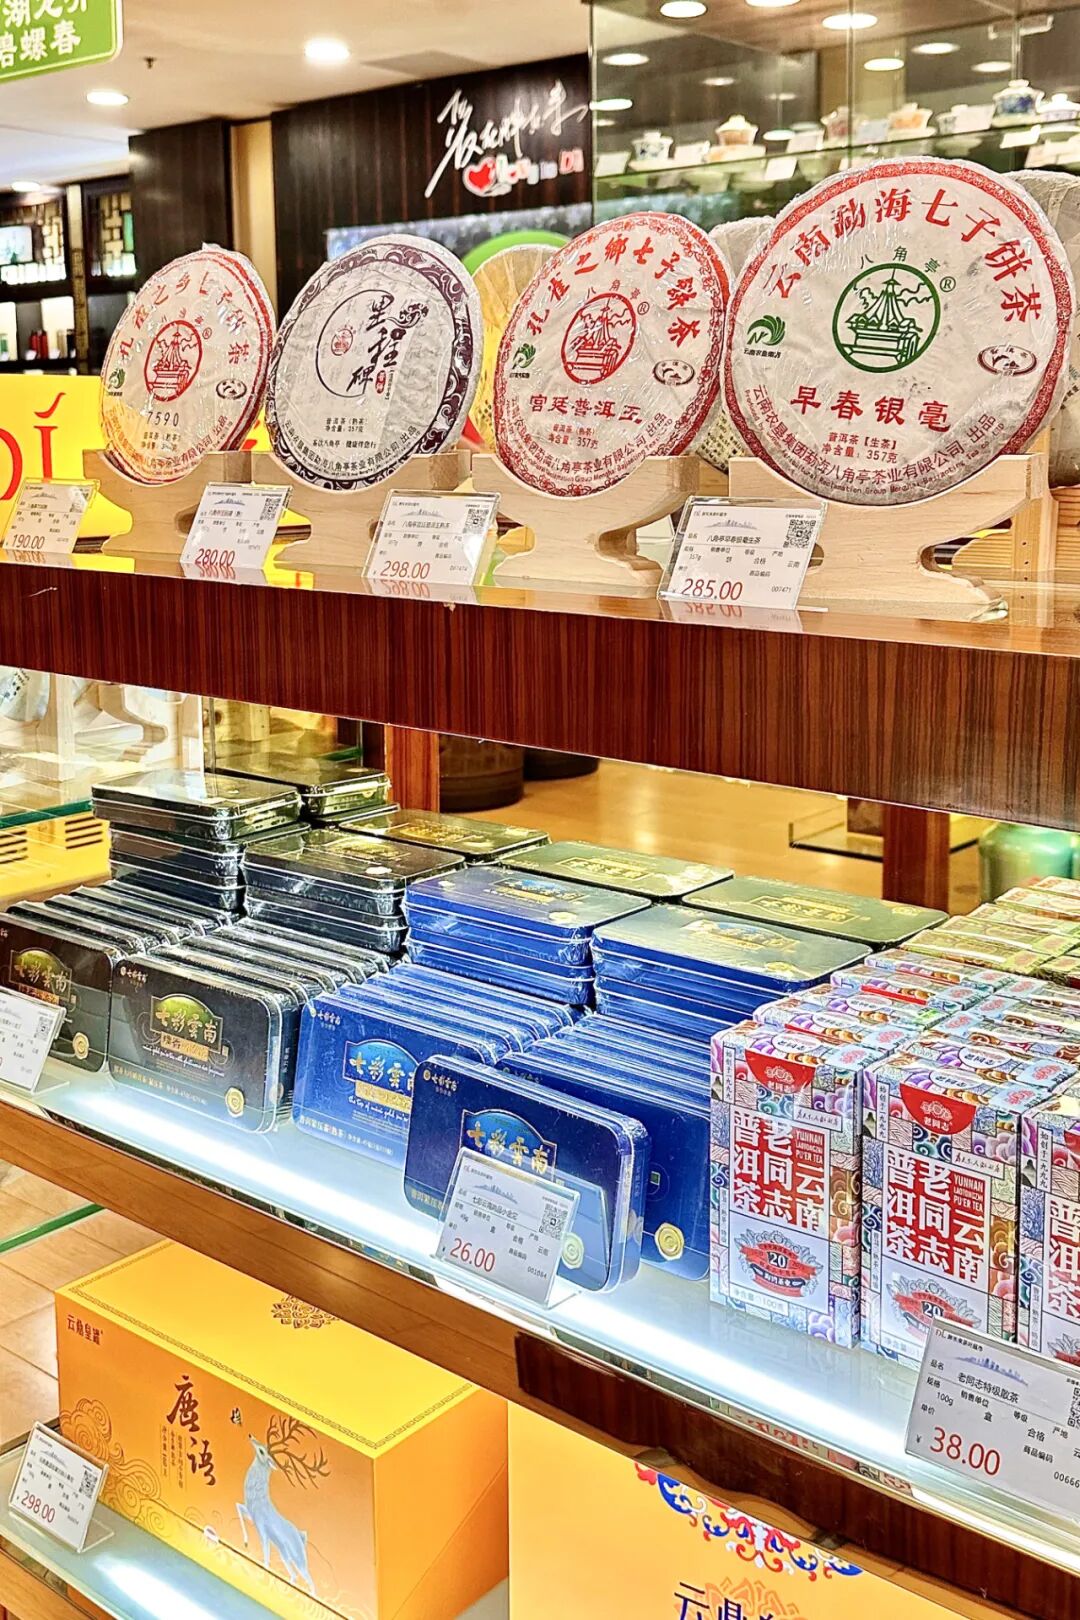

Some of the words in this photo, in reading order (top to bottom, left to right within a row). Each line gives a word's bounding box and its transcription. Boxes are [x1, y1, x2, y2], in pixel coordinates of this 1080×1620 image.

[860, 245, 941, 274] 八角亭
[146, 411, 179, 427] 7590
[790, 386, 951, 432] 早春银毫
[12, 534, 45, 550] 190.00
[195, 548, 235, 567] 280.00
[380, 560, 430, 580] 298.00
[681, 578, 743, 601] 285.00
[155, 1007, 218, 1044] 七彩雲南
[466, 1120, 548, 1175] 七彩雲南
[734, 1110, 770, 1218] 普洱茶
[1040, 1131, 1049, 1190] 始创于一九九九
[763, 1116, 797, 1226] 老同志
[953, 1173, 984, 1192] YUNNAN
[794, 1162, 825, 1232] 云南
[888, 1149, 925, 1265] 普洱茶
[919, 1158, 955, 1276] 老同志
[450, 1237, 496, 1273] 26.00
[769, 1252, 786, 1268] 20
[952, 1208, 985, 1283] 云南
[929, 1359, 945, 1371] 品名
[957, 1371, 1021, 1405] 老同志特级散茶
[936, 1391, 955, 1407] 100g
[1027, 1427, 1046, 1443] 合格
[960, 1390, 990, 1409] 销售单位
[1052, 1425, 1069, 1440] 产地
[930, 1426, 1001, 1477] 38.00
[1023, 1445, 1054, 1464] 商品编码
[21, 1490, 56, 1523] 298.00
